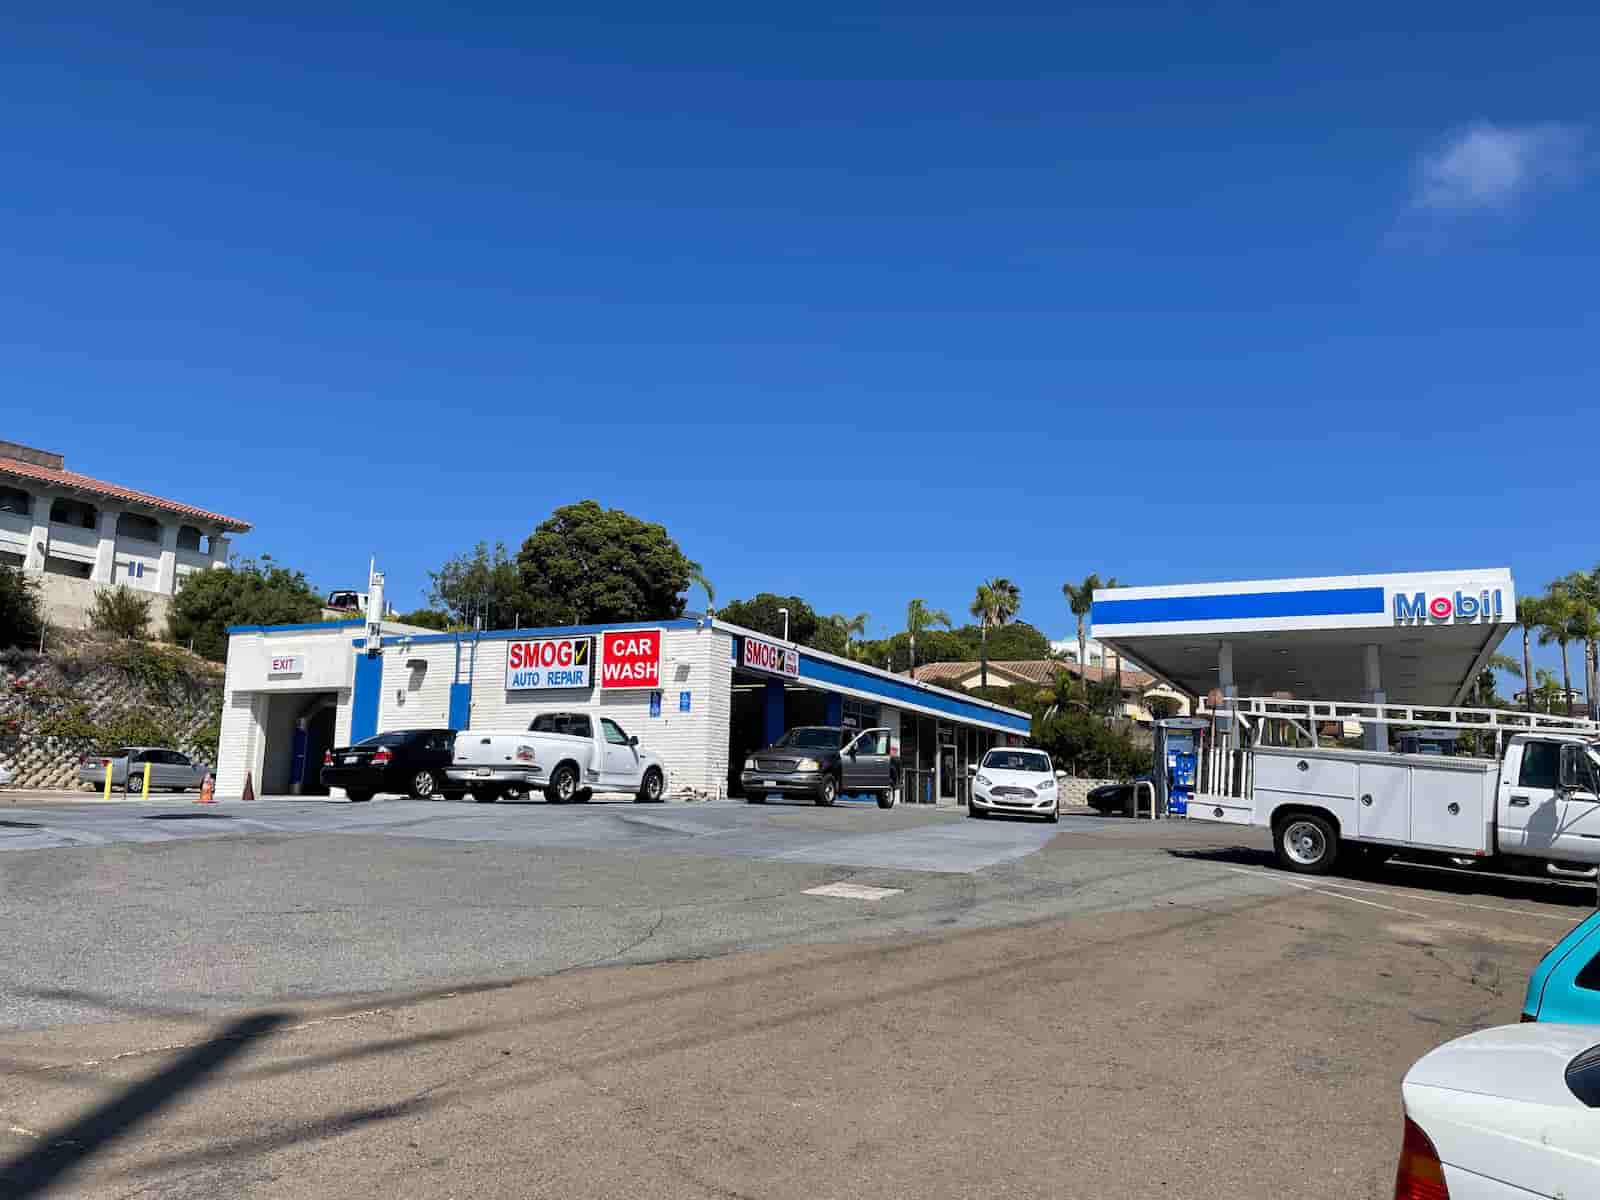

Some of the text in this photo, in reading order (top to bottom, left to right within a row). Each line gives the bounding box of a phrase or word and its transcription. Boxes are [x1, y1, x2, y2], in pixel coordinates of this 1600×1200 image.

[1393, 589, 1503, 619] Mobil
[510, 641, 572, 668] SMOG
[612, 638, 651, 656] CAR
[746, 639, 776, 668] SMOG
[272, 658, 296, 671] EXIT
[603, 661, 659, 681] WASH
[512, 670, 584, 687] AUTO REPAIR
